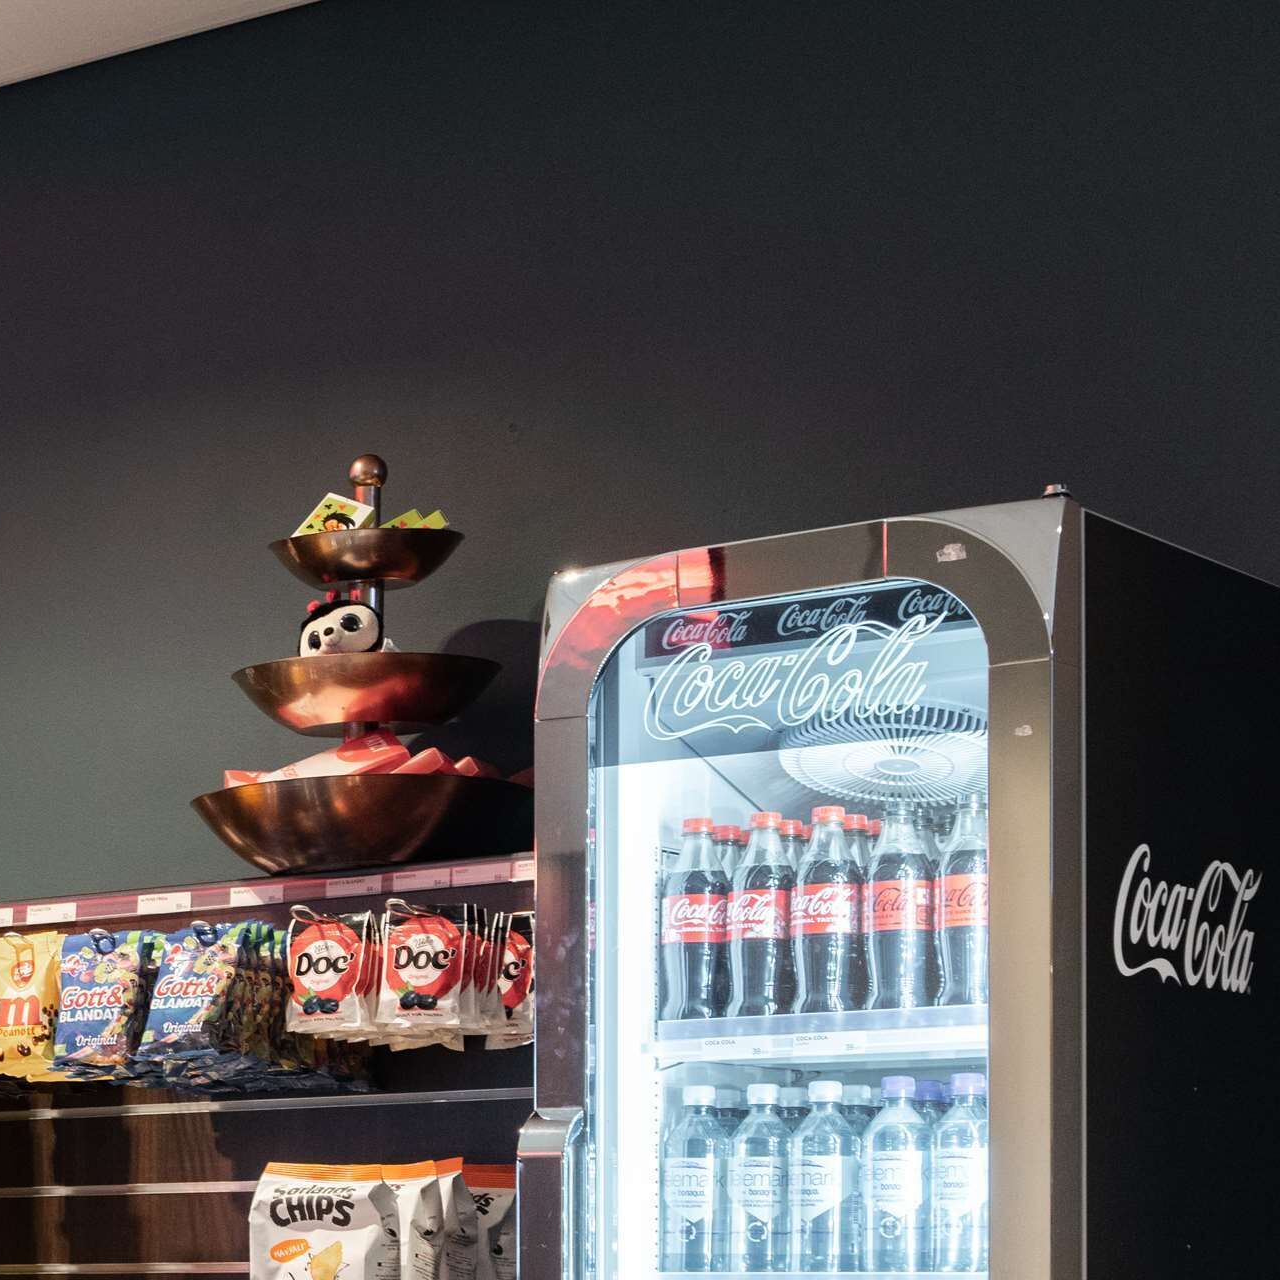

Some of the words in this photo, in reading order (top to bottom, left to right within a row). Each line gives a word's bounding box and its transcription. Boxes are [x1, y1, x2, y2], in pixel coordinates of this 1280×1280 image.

[644, 611, 948, 740] Coca-Cola
[1114, 843, 1263, 994] Coca-Cola
[150, 997, 212, 1009] BLANDAT
[60, 1008, 120, 1022] BLANDAT
[163, 1022, 203, 1034] Original
[76, 1035, 117, 1047] Original
[269, 1198, 355, 1227] CHIPS
